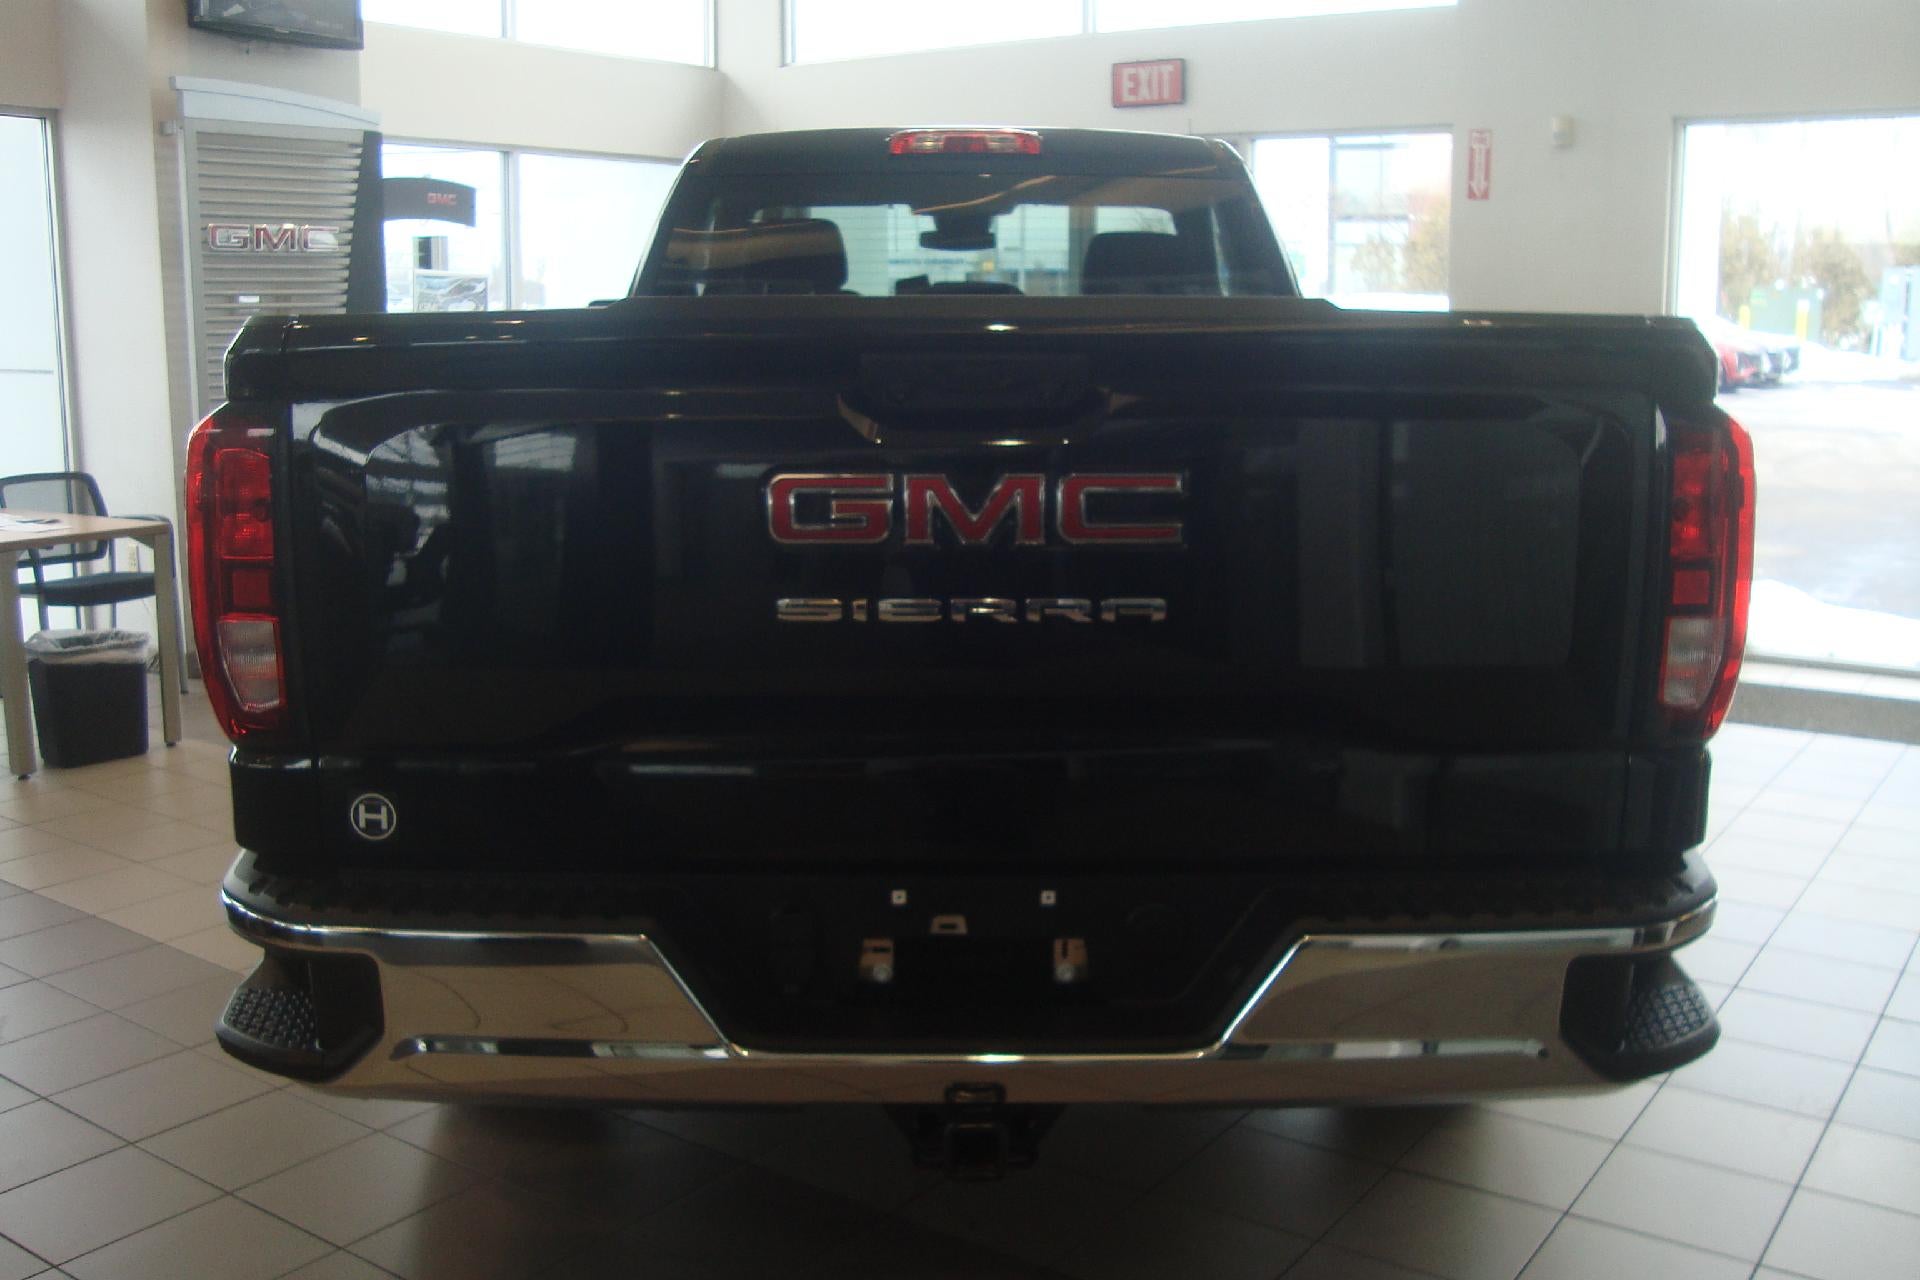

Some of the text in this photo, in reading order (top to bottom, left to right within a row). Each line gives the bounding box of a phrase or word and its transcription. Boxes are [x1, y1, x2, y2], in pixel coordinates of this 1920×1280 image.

[1123, 64, 1175, 102] EXIT
[427, 193, 457, 205] GMC
[208, 223, 339, 251] GMC
[769, 473, 1184, 544] GMC
[776, 598, 1168, 622] SIERRA
